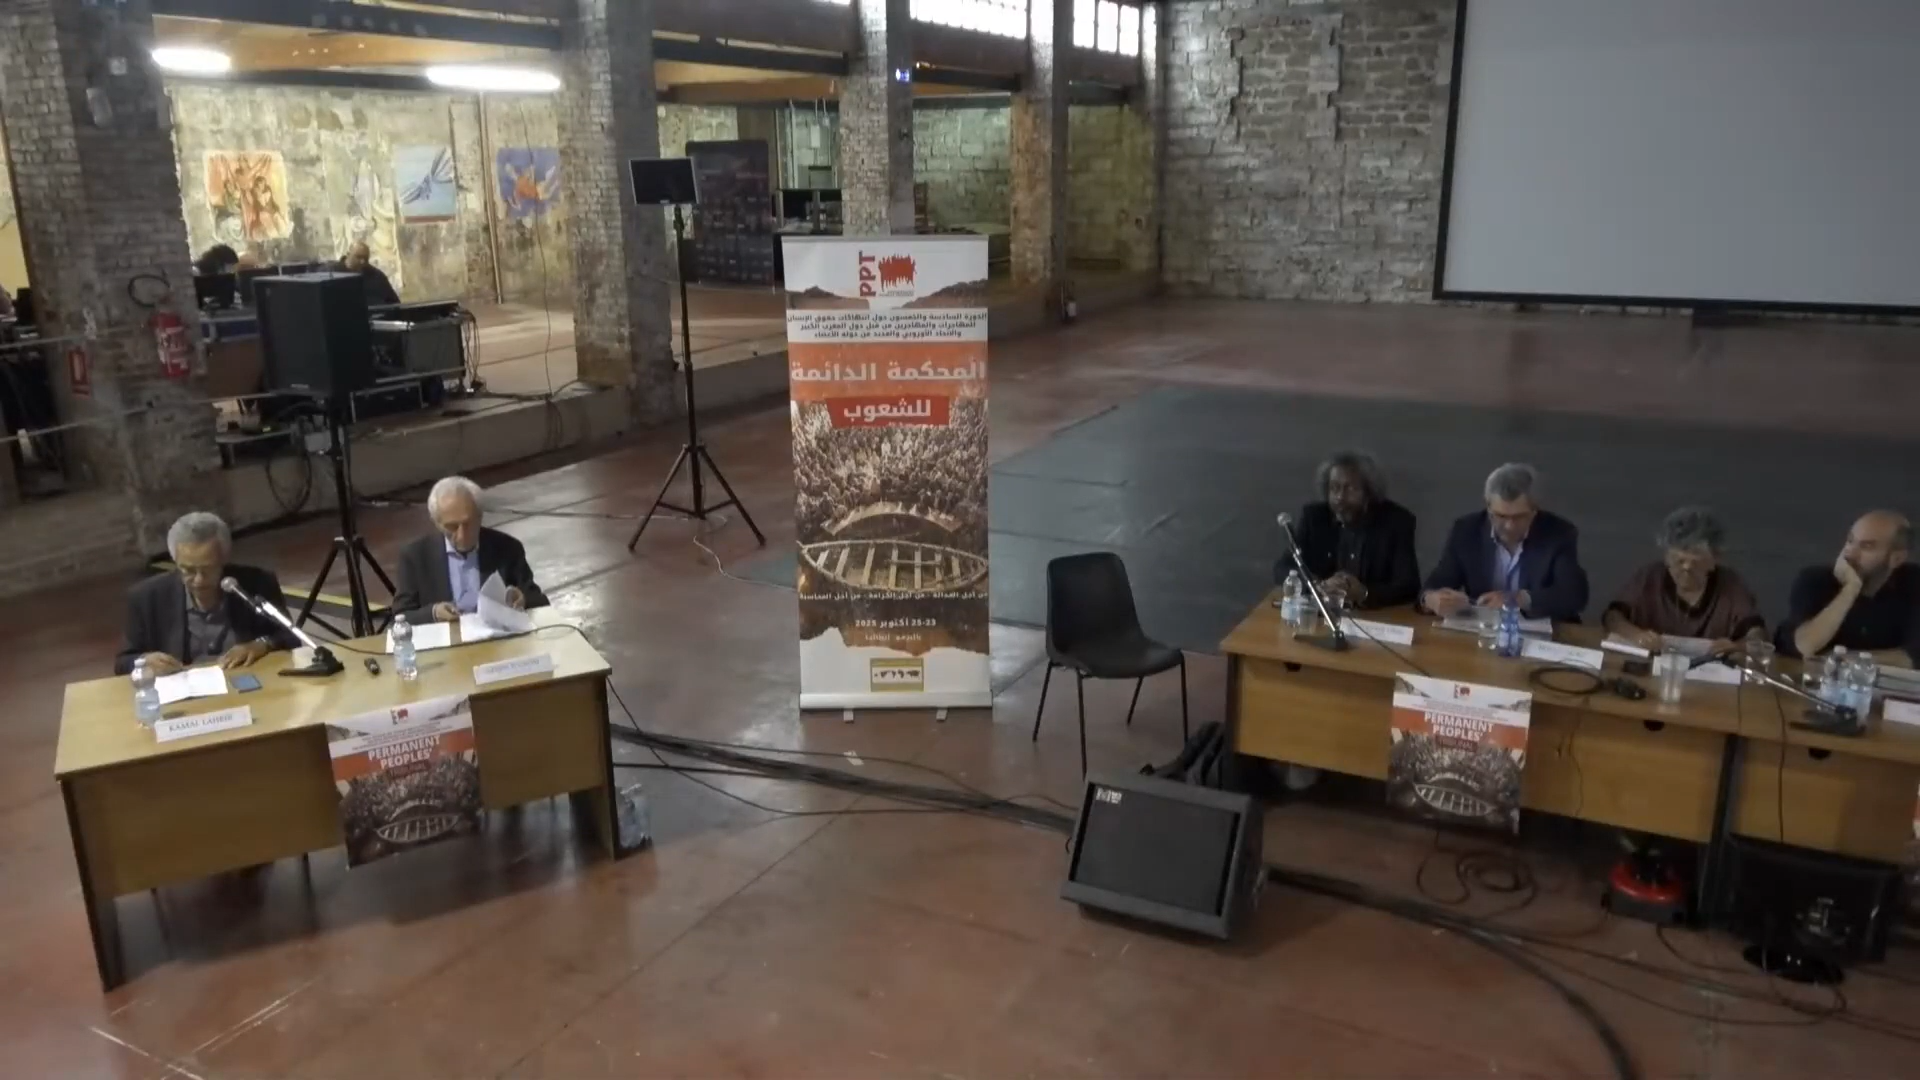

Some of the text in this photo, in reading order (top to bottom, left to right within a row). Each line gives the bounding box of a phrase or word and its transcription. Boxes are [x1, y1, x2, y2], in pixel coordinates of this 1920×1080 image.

[859, 250, 876, 297] PPT
[791, 361, 985, 381] المحكمة الدائمة
[843, 398, 931, 422] للشعوب
[855, 619, 877, 627] 2025
[880, 616, 909, 628] أكتوبر
[1424, 710, 1495, 733] PERMANENT
[367, 735, 441, 762] PERMANENT
